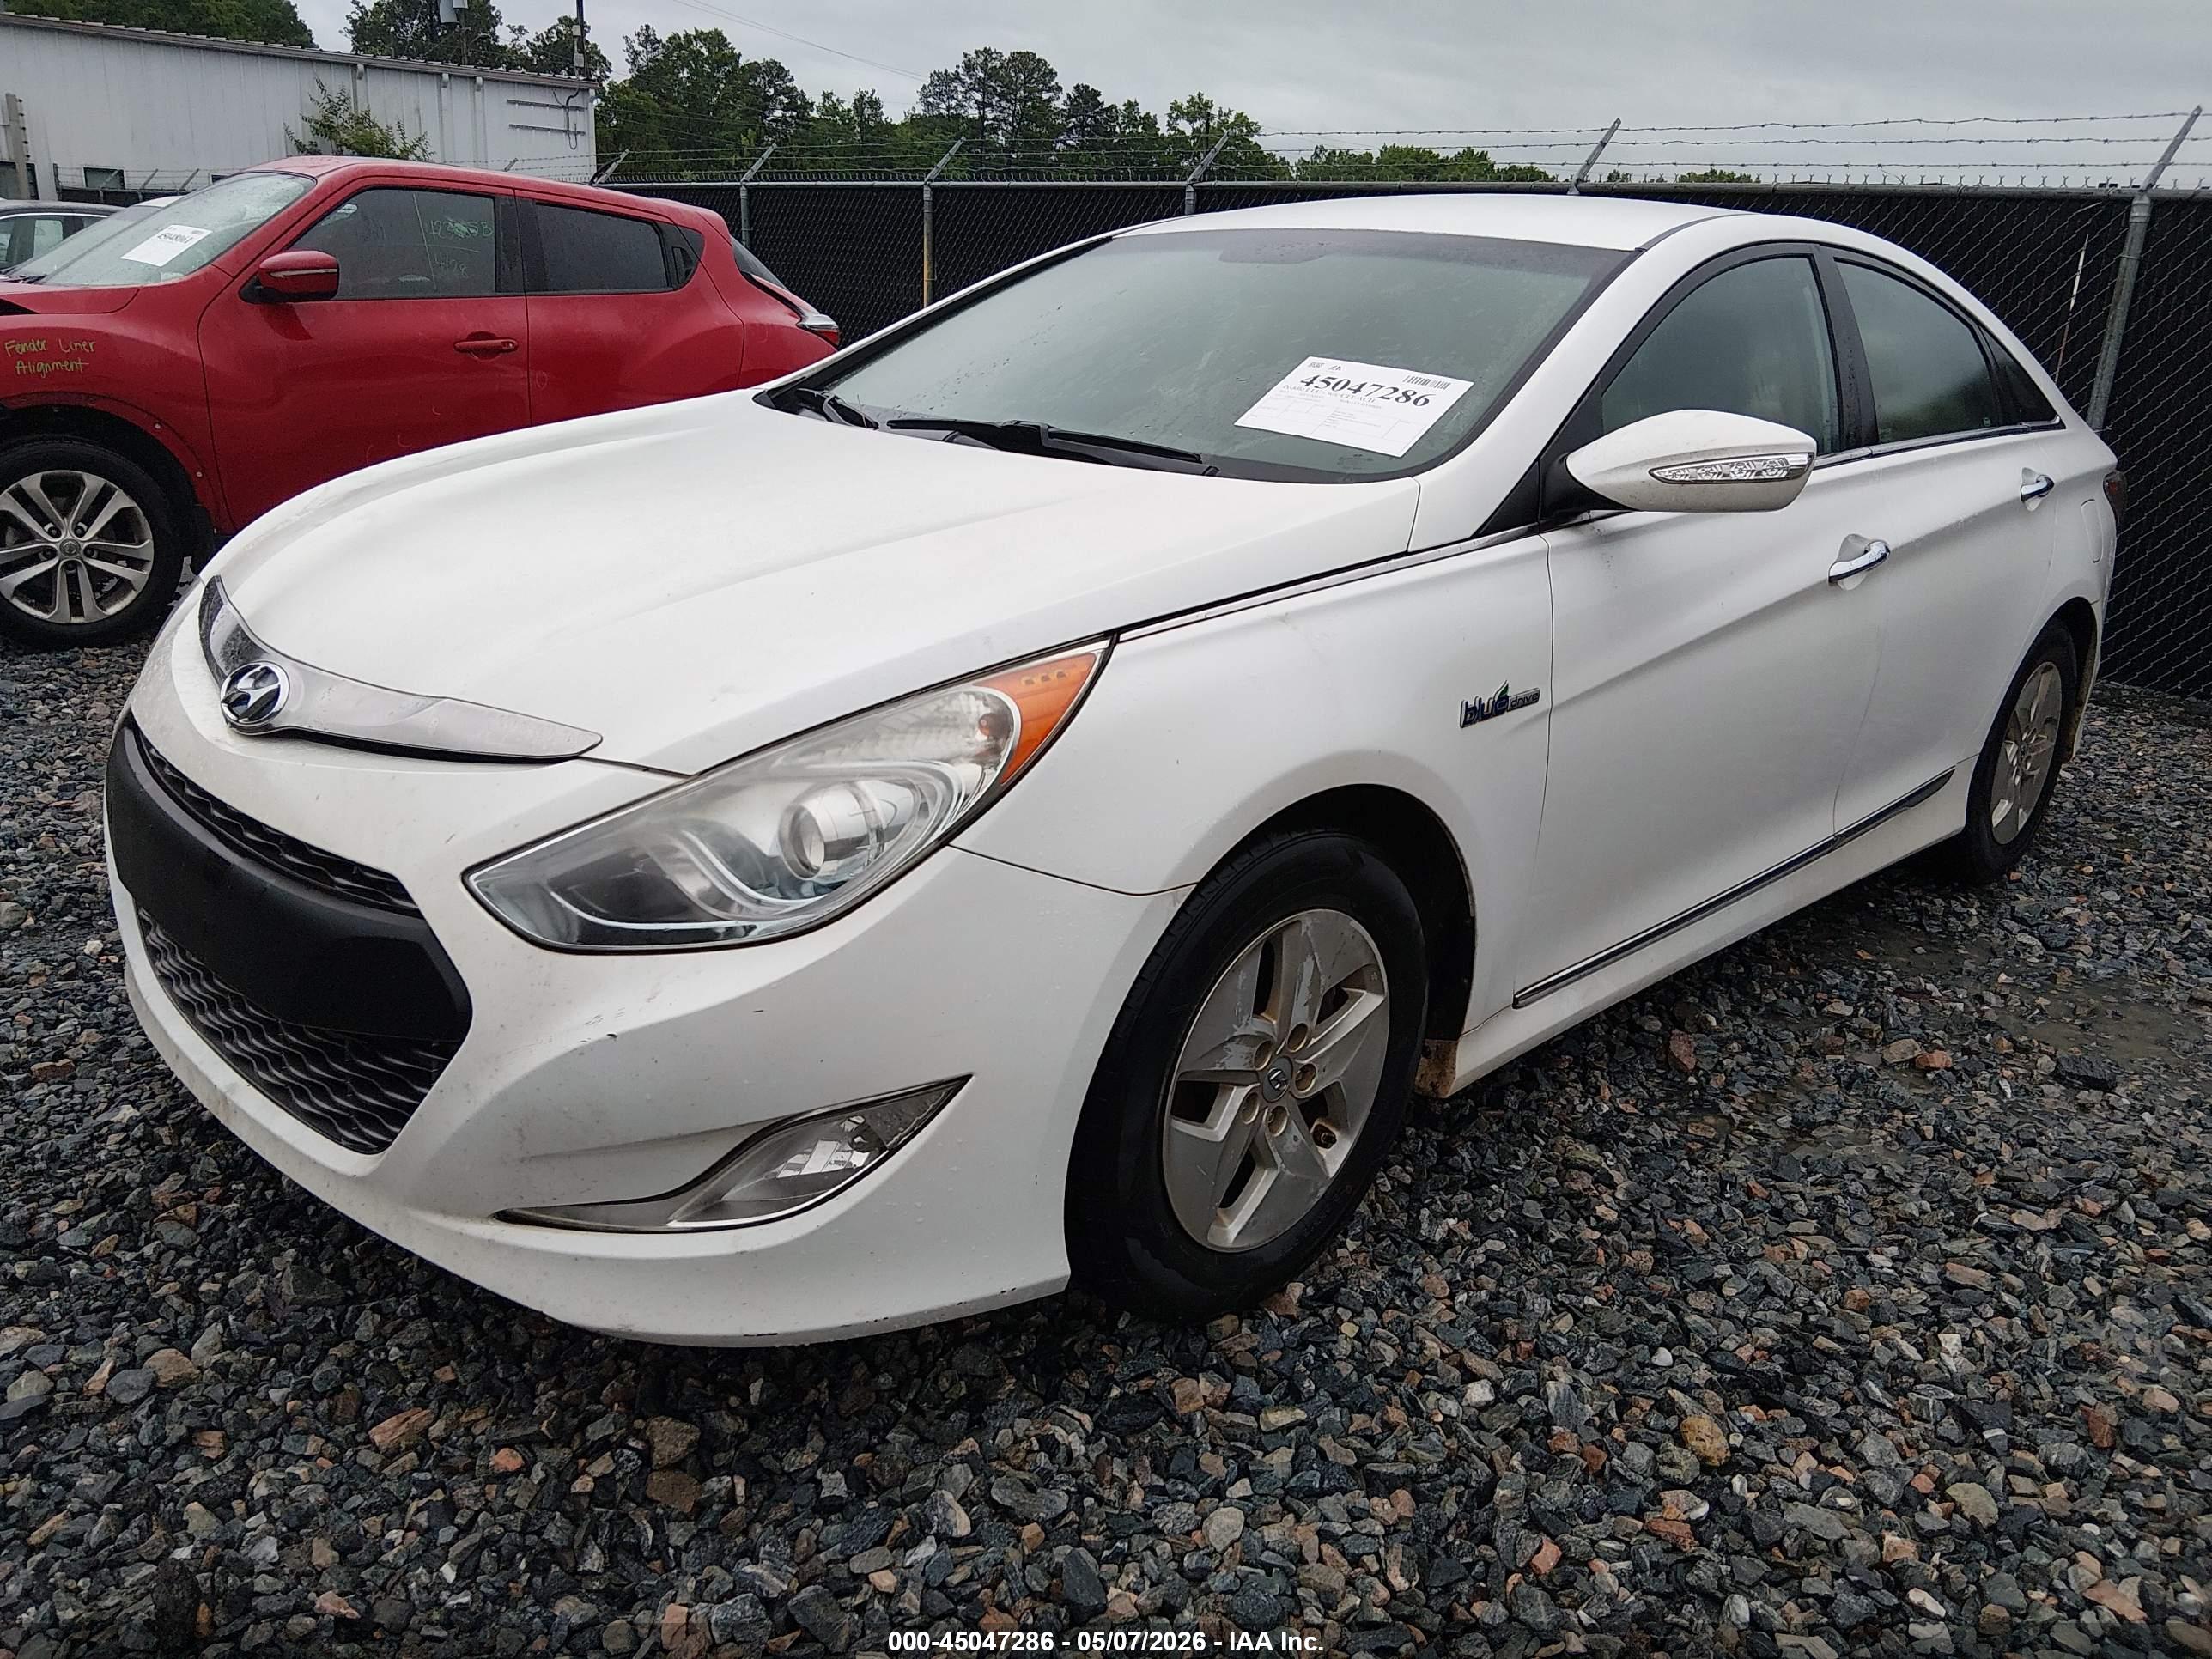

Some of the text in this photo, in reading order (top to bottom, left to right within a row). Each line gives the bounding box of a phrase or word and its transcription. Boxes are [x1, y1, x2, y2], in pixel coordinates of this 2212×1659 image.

[4, 337, 96, 357] Fender Liner
[15, 356, 89, 379] Alignment
[1299, 374, 1437, 407] 45047286
[1460, 682, 1540, 728] blue drive
